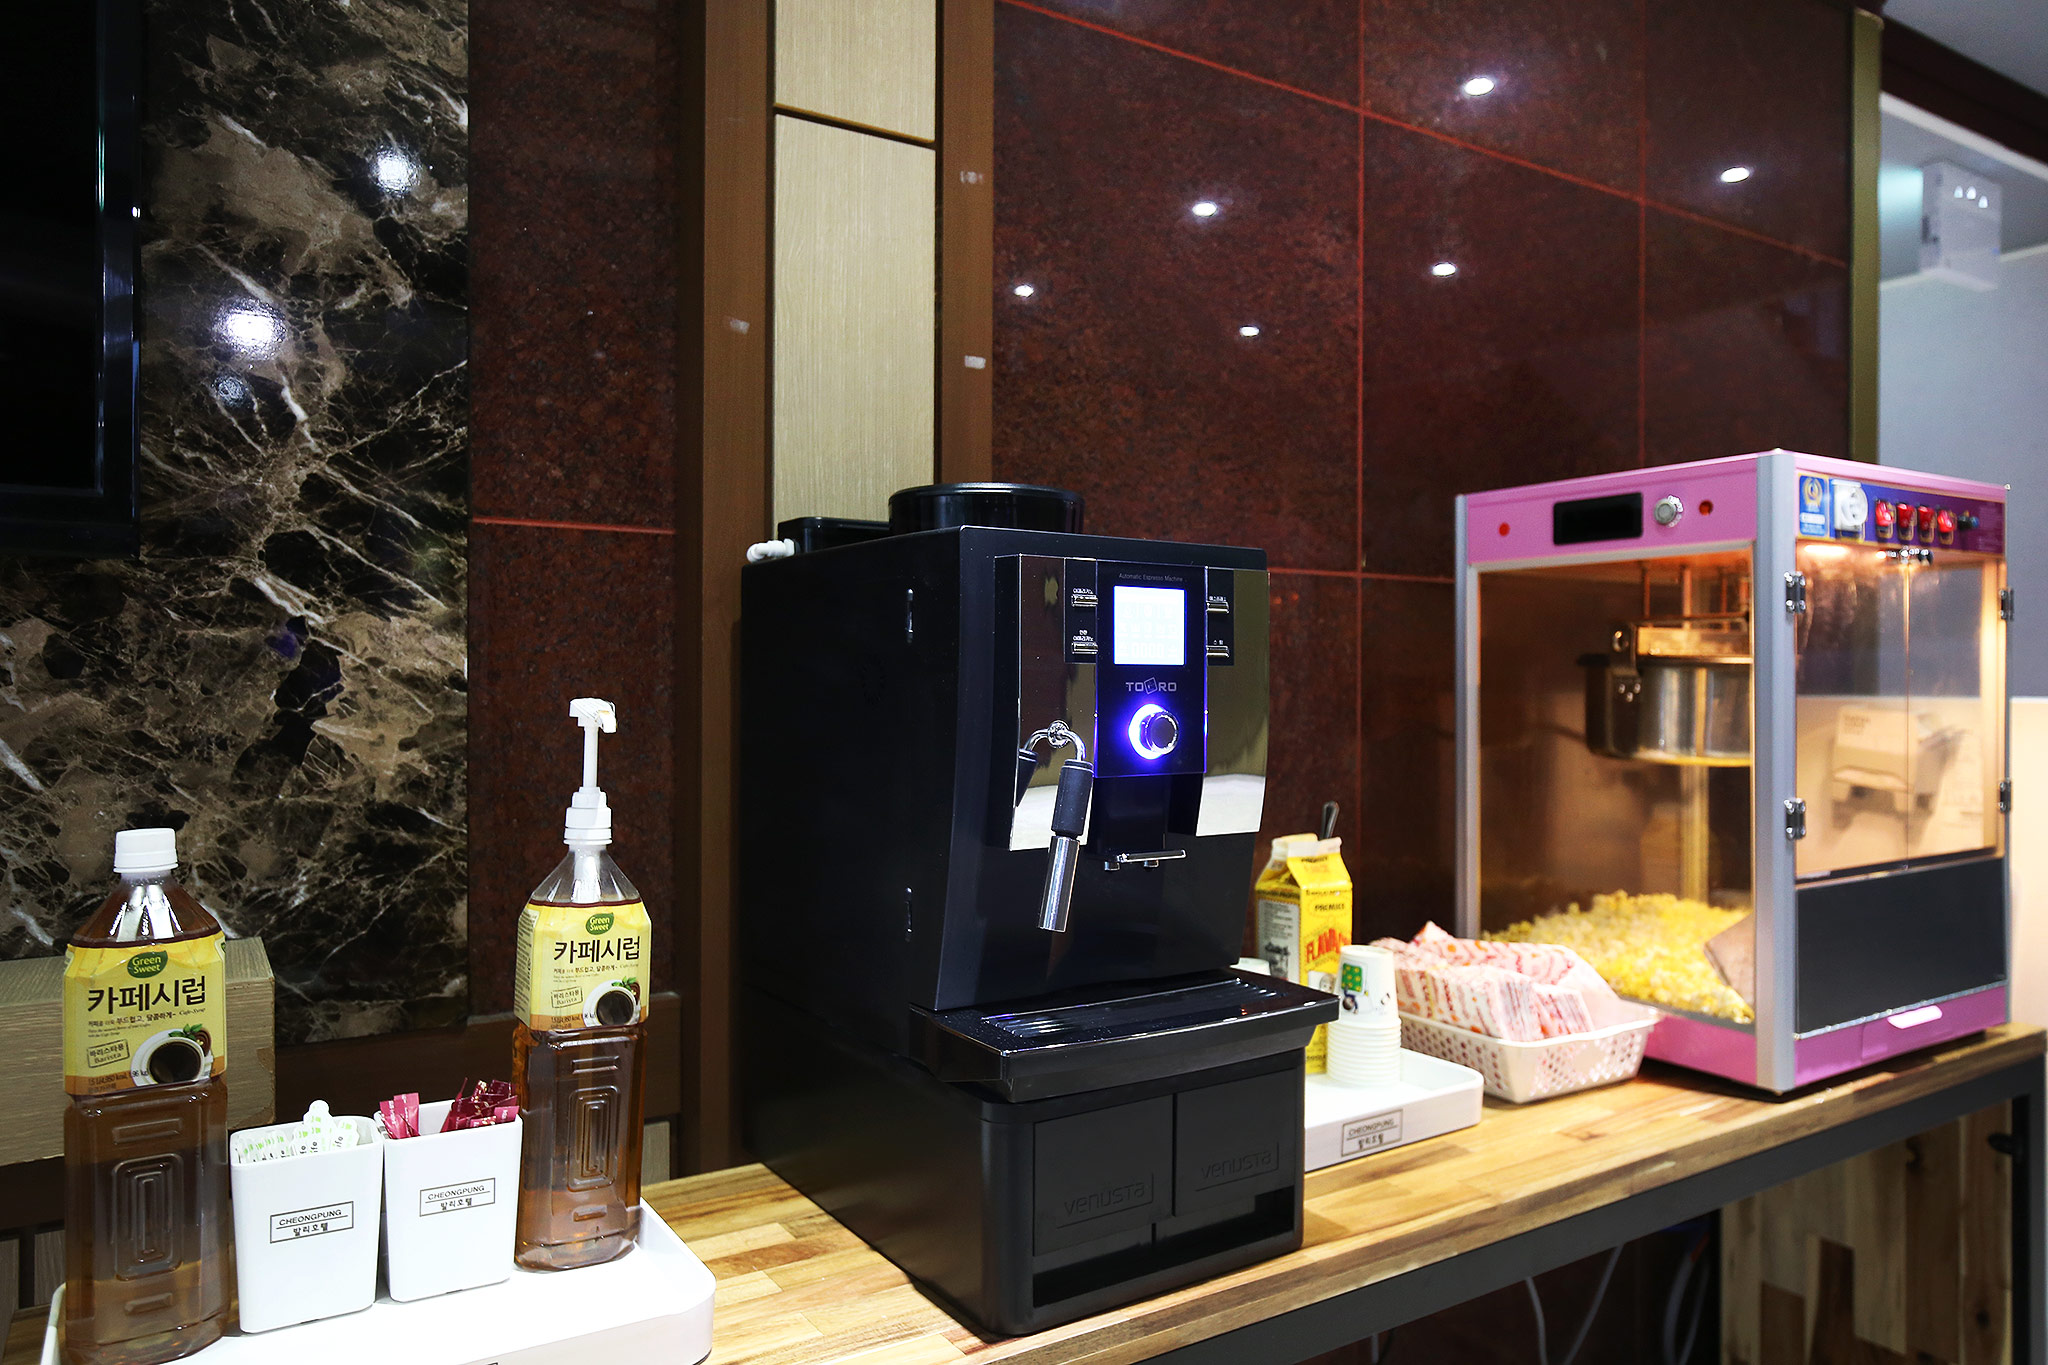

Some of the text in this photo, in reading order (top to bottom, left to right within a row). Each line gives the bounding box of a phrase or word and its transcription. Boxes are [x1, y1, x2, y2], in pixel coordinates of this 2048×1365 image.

[590, 917, 611, 925] Green
[554, 936, 641, 964] 카페시럽
[132, 956, 162, 966] Green
[133, 964, 161, 974] Sweet
[88, 976, 206, 1014] 카페시럽
[95, 1053, 122, 1063] Barista
[428, 1185, 485, 1200] CHEONGPUNG
[279, 1209, 342, 1226] CHEONGPUNG
